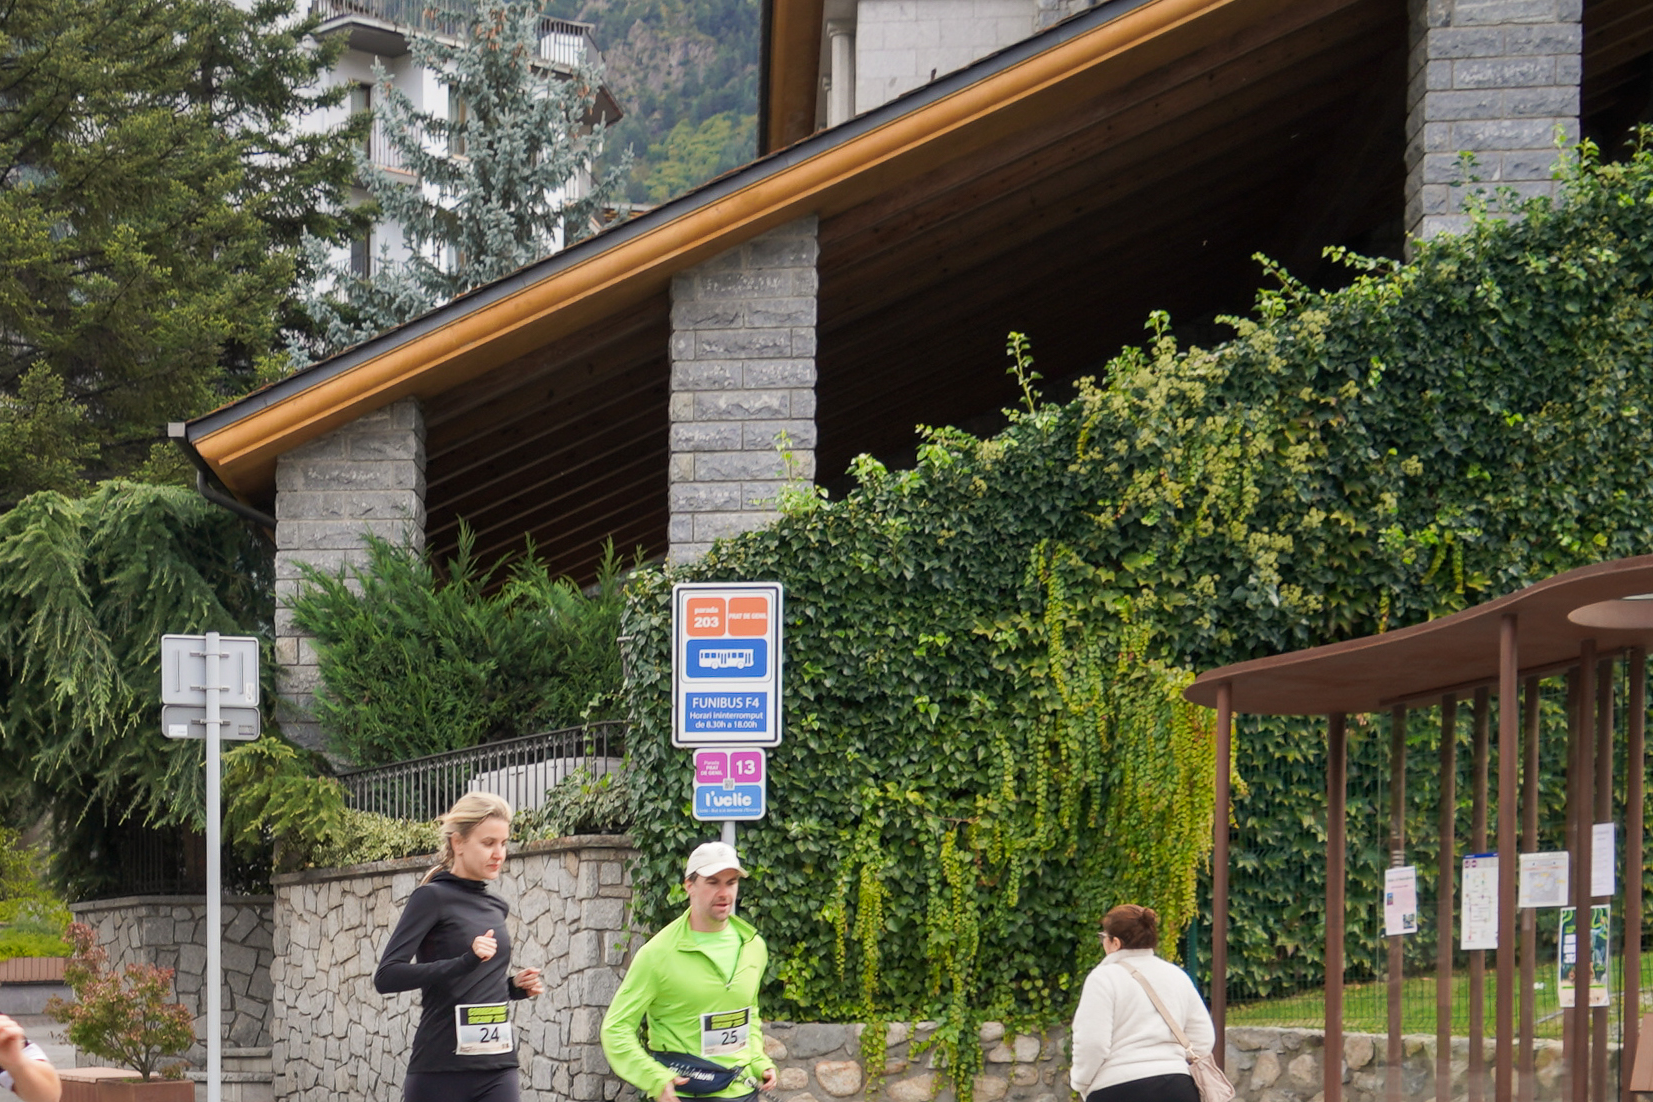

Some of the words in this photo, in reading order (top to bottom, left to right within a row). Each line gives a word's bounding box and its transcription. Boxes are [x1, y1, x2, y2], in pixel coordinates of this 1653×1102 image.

[693, 616, 719, 628] 203
[692, 697, 743, 708] FUNIBUS
[745, 697, 760, 708] F4
[689, 711, 712, 720] Horari
[713, 711, 763, 721] ininterromput
[695, 720, 705, 729] de
[706, 720, 726, 729] 8.30h
[734, 720, 758, 729] 18.00h
[736, 759, 755, 775] 13
[705, 790, 752, 807] l'uclic
[479, 1026, 500, 1044] 24
[721, 1030, 738, 1046] 25
